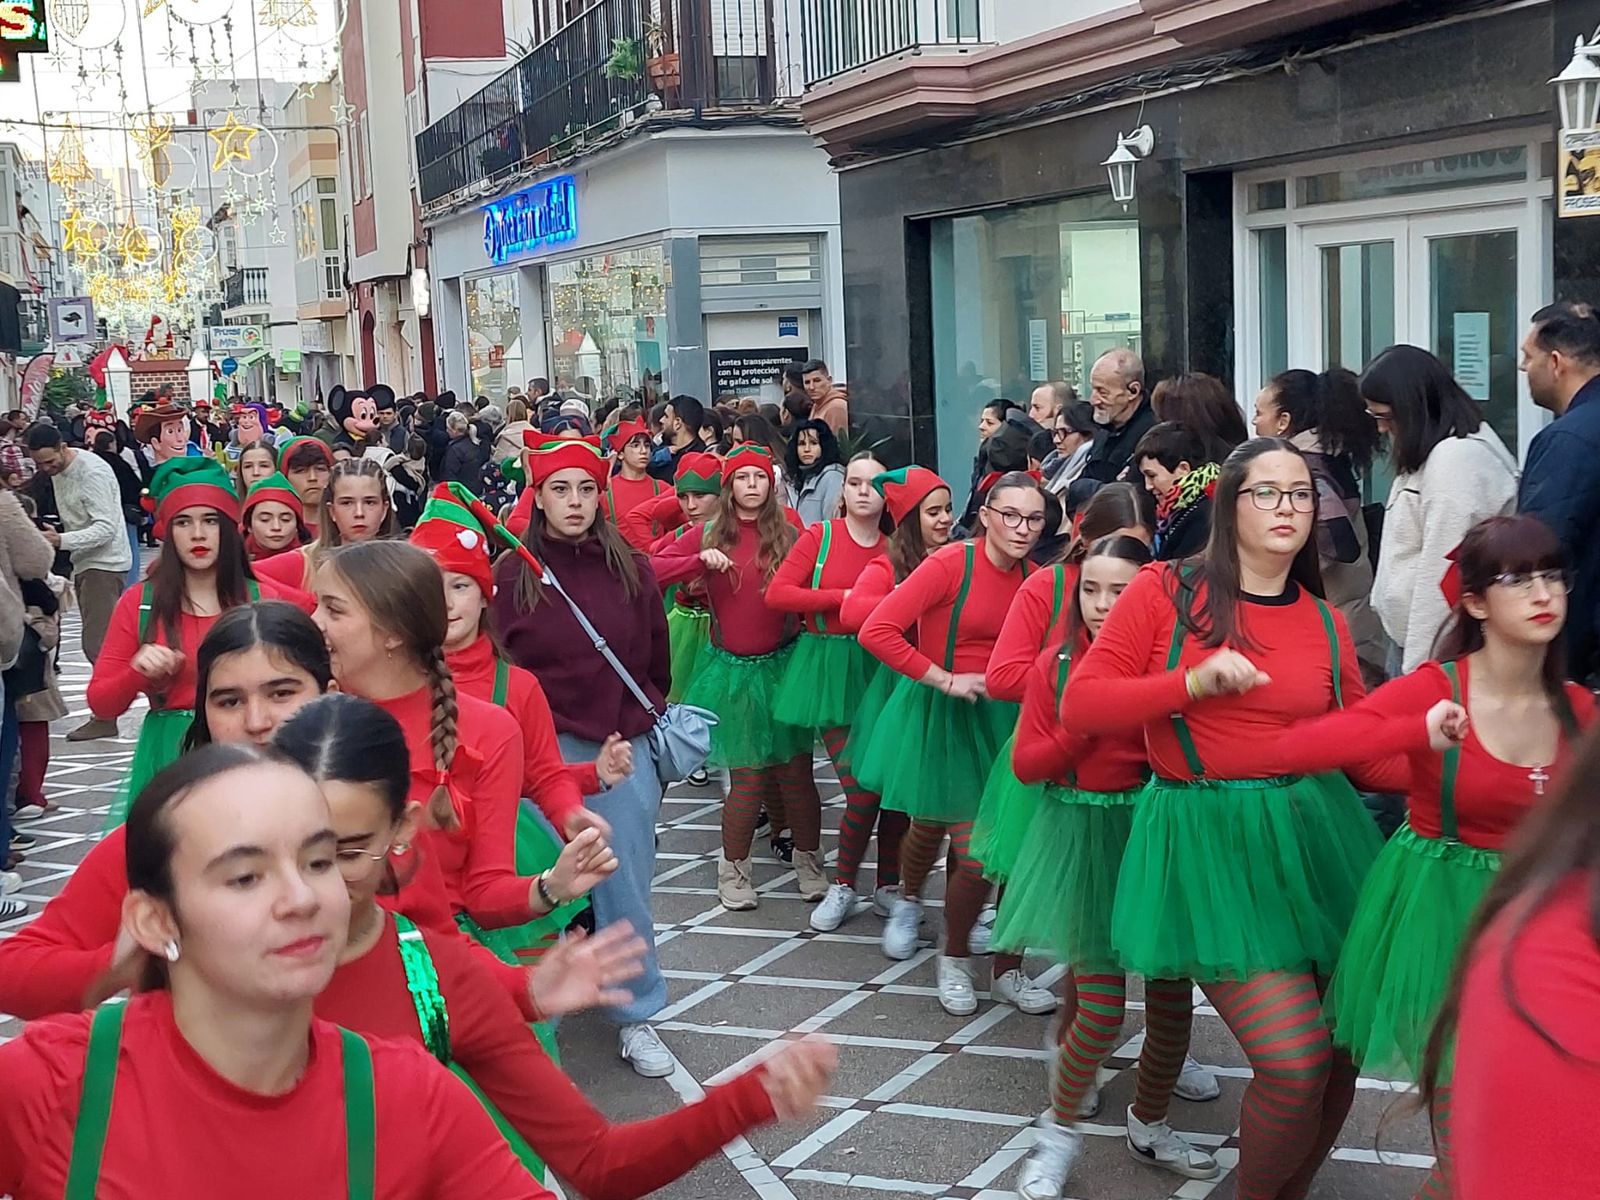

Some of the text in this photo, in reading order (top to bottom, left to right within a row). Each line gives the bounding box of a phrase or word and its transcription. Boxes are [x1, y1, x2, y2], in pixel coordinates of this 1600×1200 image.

[717, 357, 793, 367] Lentes transparentes
[733, 368, 740, 376] la
[741, 367, 780, 377] protección
[718, 376, 773, 387] de gafas de sol
